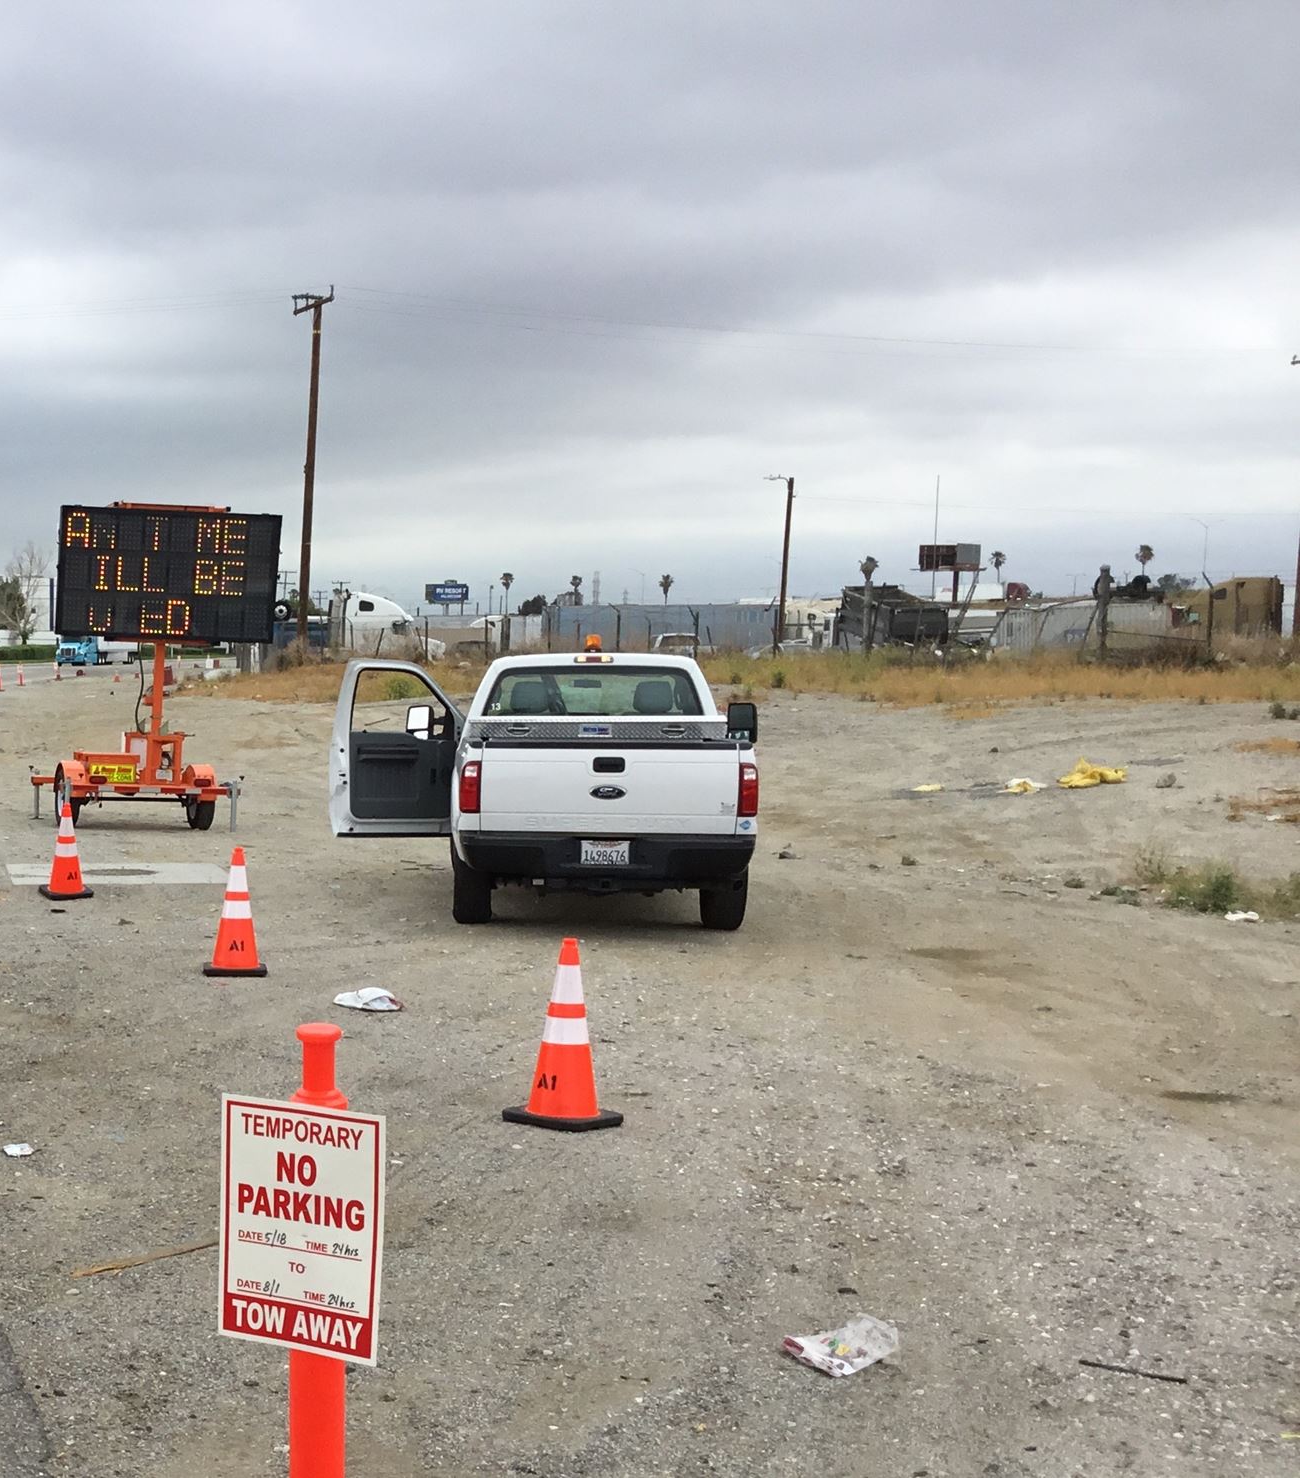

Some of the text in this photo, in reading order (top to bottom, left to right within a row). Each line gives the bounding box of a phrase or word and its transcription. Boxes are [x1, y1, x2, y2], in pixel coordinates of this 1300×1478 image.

[194, 560, 245, 596] BE
[491, 702, 501, 711] 13
[584, 849, 626, 862] 1498676
[66, 871, 78, 881] A1
[229, 939, 244, 952] A1
[537, 1073, 557, 1091] A1
[241, 1112, 363, 1150] TEMPORARY
[276, 1151, 317, 1187] NO
[237, 1183, 365, 1232] PARKING
[238, 1229, 263, 1241] DATE
[264, 1229, 287, 1247] 5/18
[305, 1240, 328, 1253] TIME
[288, 1261, 305, 1274] TO
[236, 1278, 261, 1291] DATE
[262, 1279, 280, 1297] 8/1
[303, 1290, 326, 1303] TIME
[232, 1299, 363, 1350] TOW AWAY
